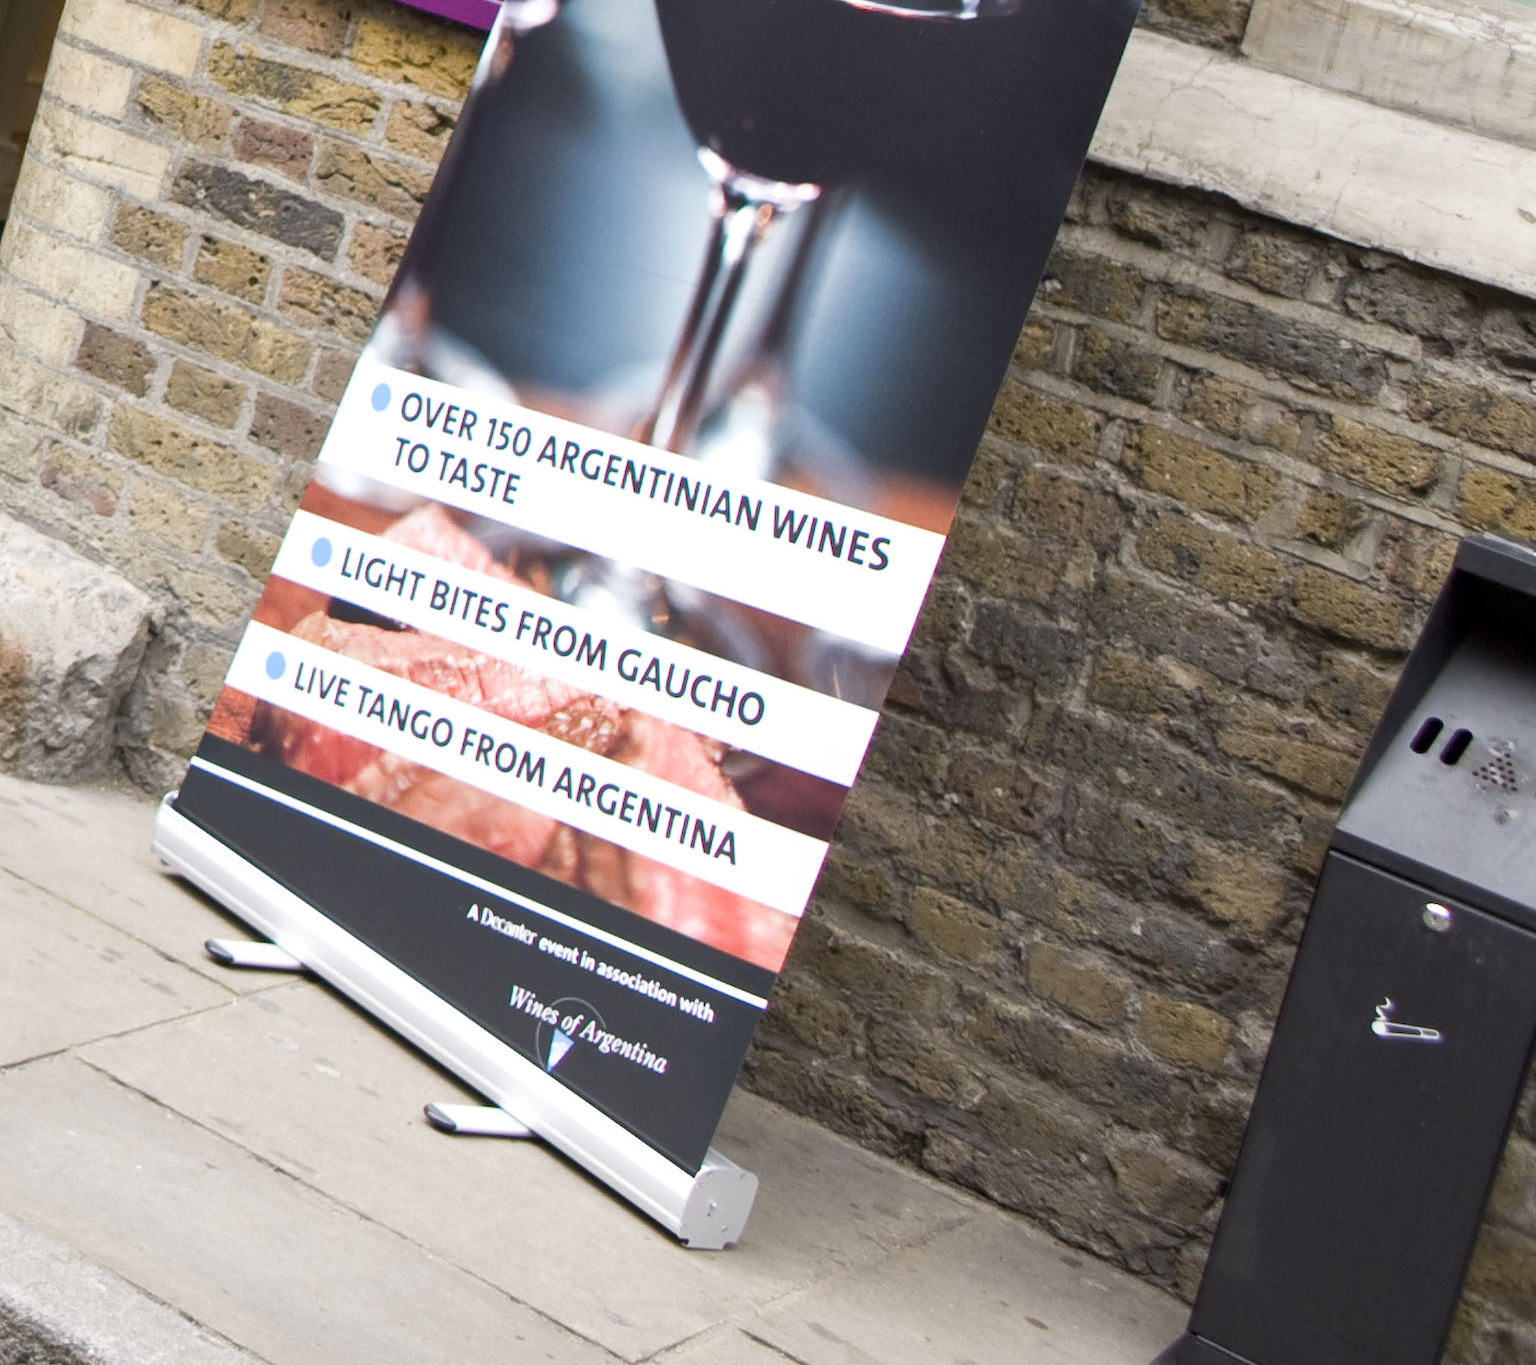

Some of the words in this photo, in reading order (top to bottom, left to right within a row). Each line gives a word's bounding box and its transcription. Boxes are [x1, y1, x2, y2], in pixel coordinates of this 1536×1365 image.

[393, 436, 430, 474] TO
[438, 450, 521, 505] TASTE
[399, 391, 479, 442] OVER
[485, 417, 532, 457] 150
[537, 435, 763, 532] ARGENTINIAN
[771, 504, 892, 573] WINES
[339, 546, 426, 601] LIGHT
[428, 578, 510, 634] BITES
[515, 610, 609, 672] FROM
[616, 648, 766, 727] GAUCHO
[293, 661, 350, 707] LIVE
[356, 684, 454, 748] TANGO
[459, 728, 546, 788] FROM
[551, 766, 738, 866] ARGENTINA
[466, 903, 480, 923] A
[479, 906, 539, 947] Decanter
[538, 935, 580, 966] event
[579, 950, 596, 971] in
[595, 959, 679, 1007] association
[679, 994, 716, 1024] with
[508, 984, 560, 1026] Wines
[560, 1013, 585, 1036] of
[578, 1020, 668, 1075] Argentina
